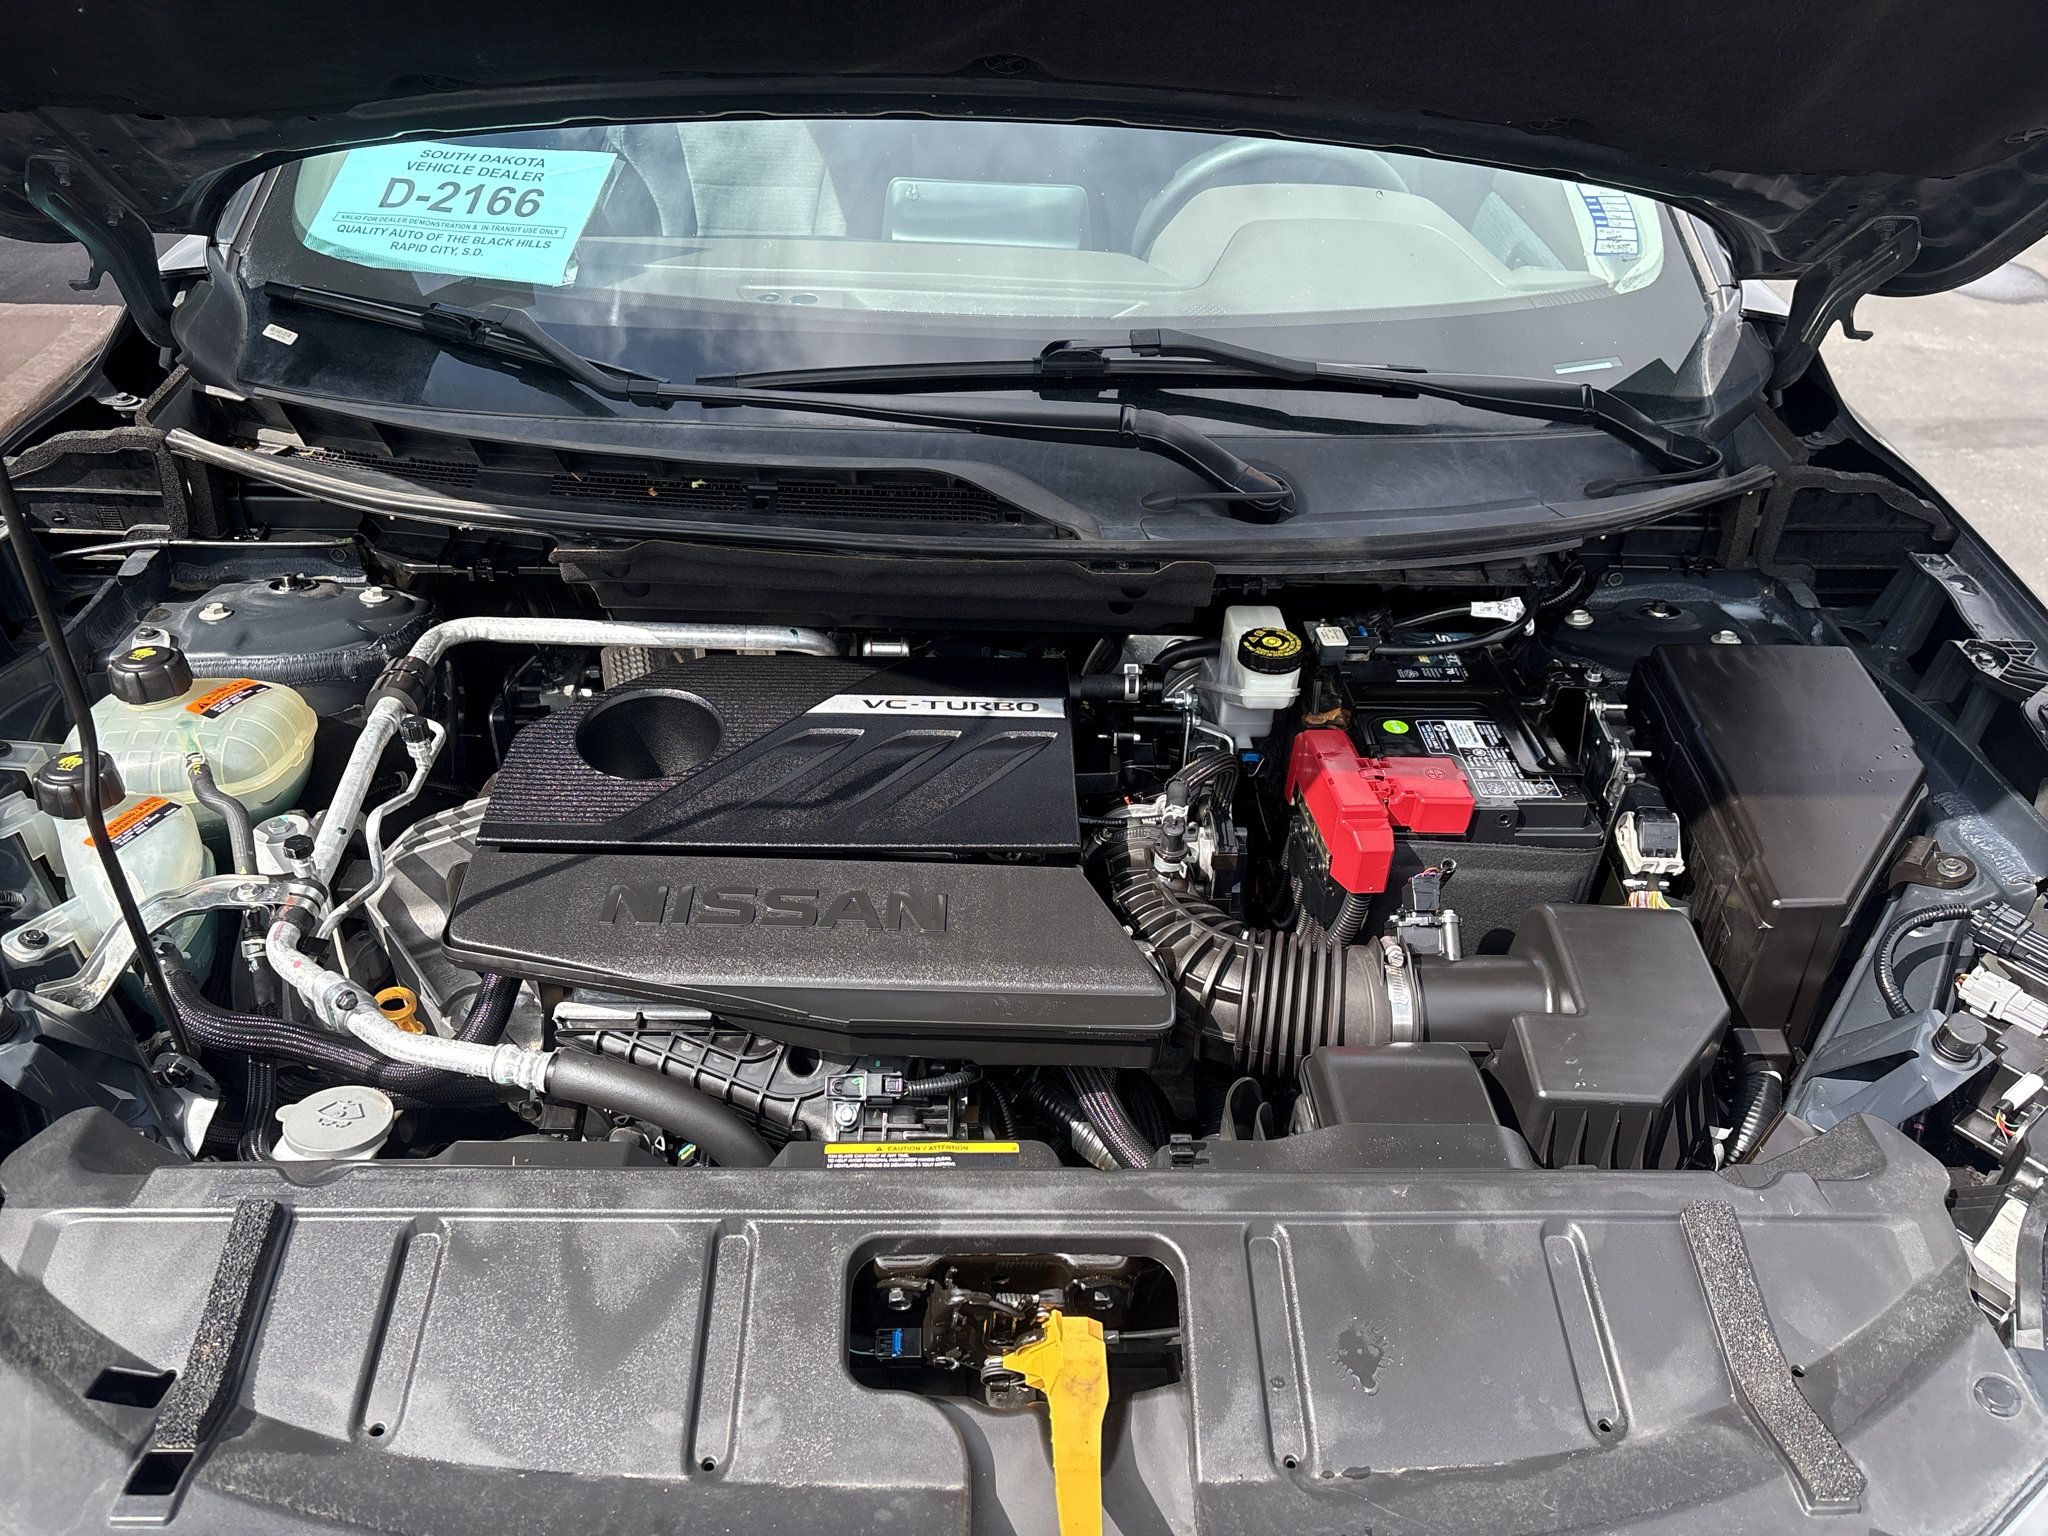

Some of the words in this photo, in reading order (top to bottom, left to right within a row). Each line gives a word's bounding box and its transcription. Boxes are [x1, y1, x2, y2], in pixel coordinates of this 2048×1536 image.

[420, 149, 476, 162] SOUTH
[479, 154, 545, 168] DAKOTA
[407, 161, 475, 175] VEHICLE
[478, 167, 545, 182] DEALER
[378, 177, 545, 218] D-2166
[379, 216, 408, 224] DEALER
[409, 218, 471, 230] DEMONSTRATION
[481, 225, 521, 233] IN-TRANSIT
[523, 226, 539, 234] USE
[540, 227, 560, 235] ONLY
[337, 224, 389, 236] QUALITY
[389, 228, 424, 240] AUTO
[426, 232, 444, 241] OF
[447, 234, 471, 244] THE
[472, 236, 514, 247] BLACK
[516, 239, 552, 249] HILLS
[390, 241, 427, 253] RAPID
[430, 245, 458, 256] CITY,
[461, 247, 484, 257] S.D.
[862, 699, 1040, 712] VC-TURBO
[599, 886, 948, 933] NISSAN
[929, 1144, 969, 1152] ATTENTION
